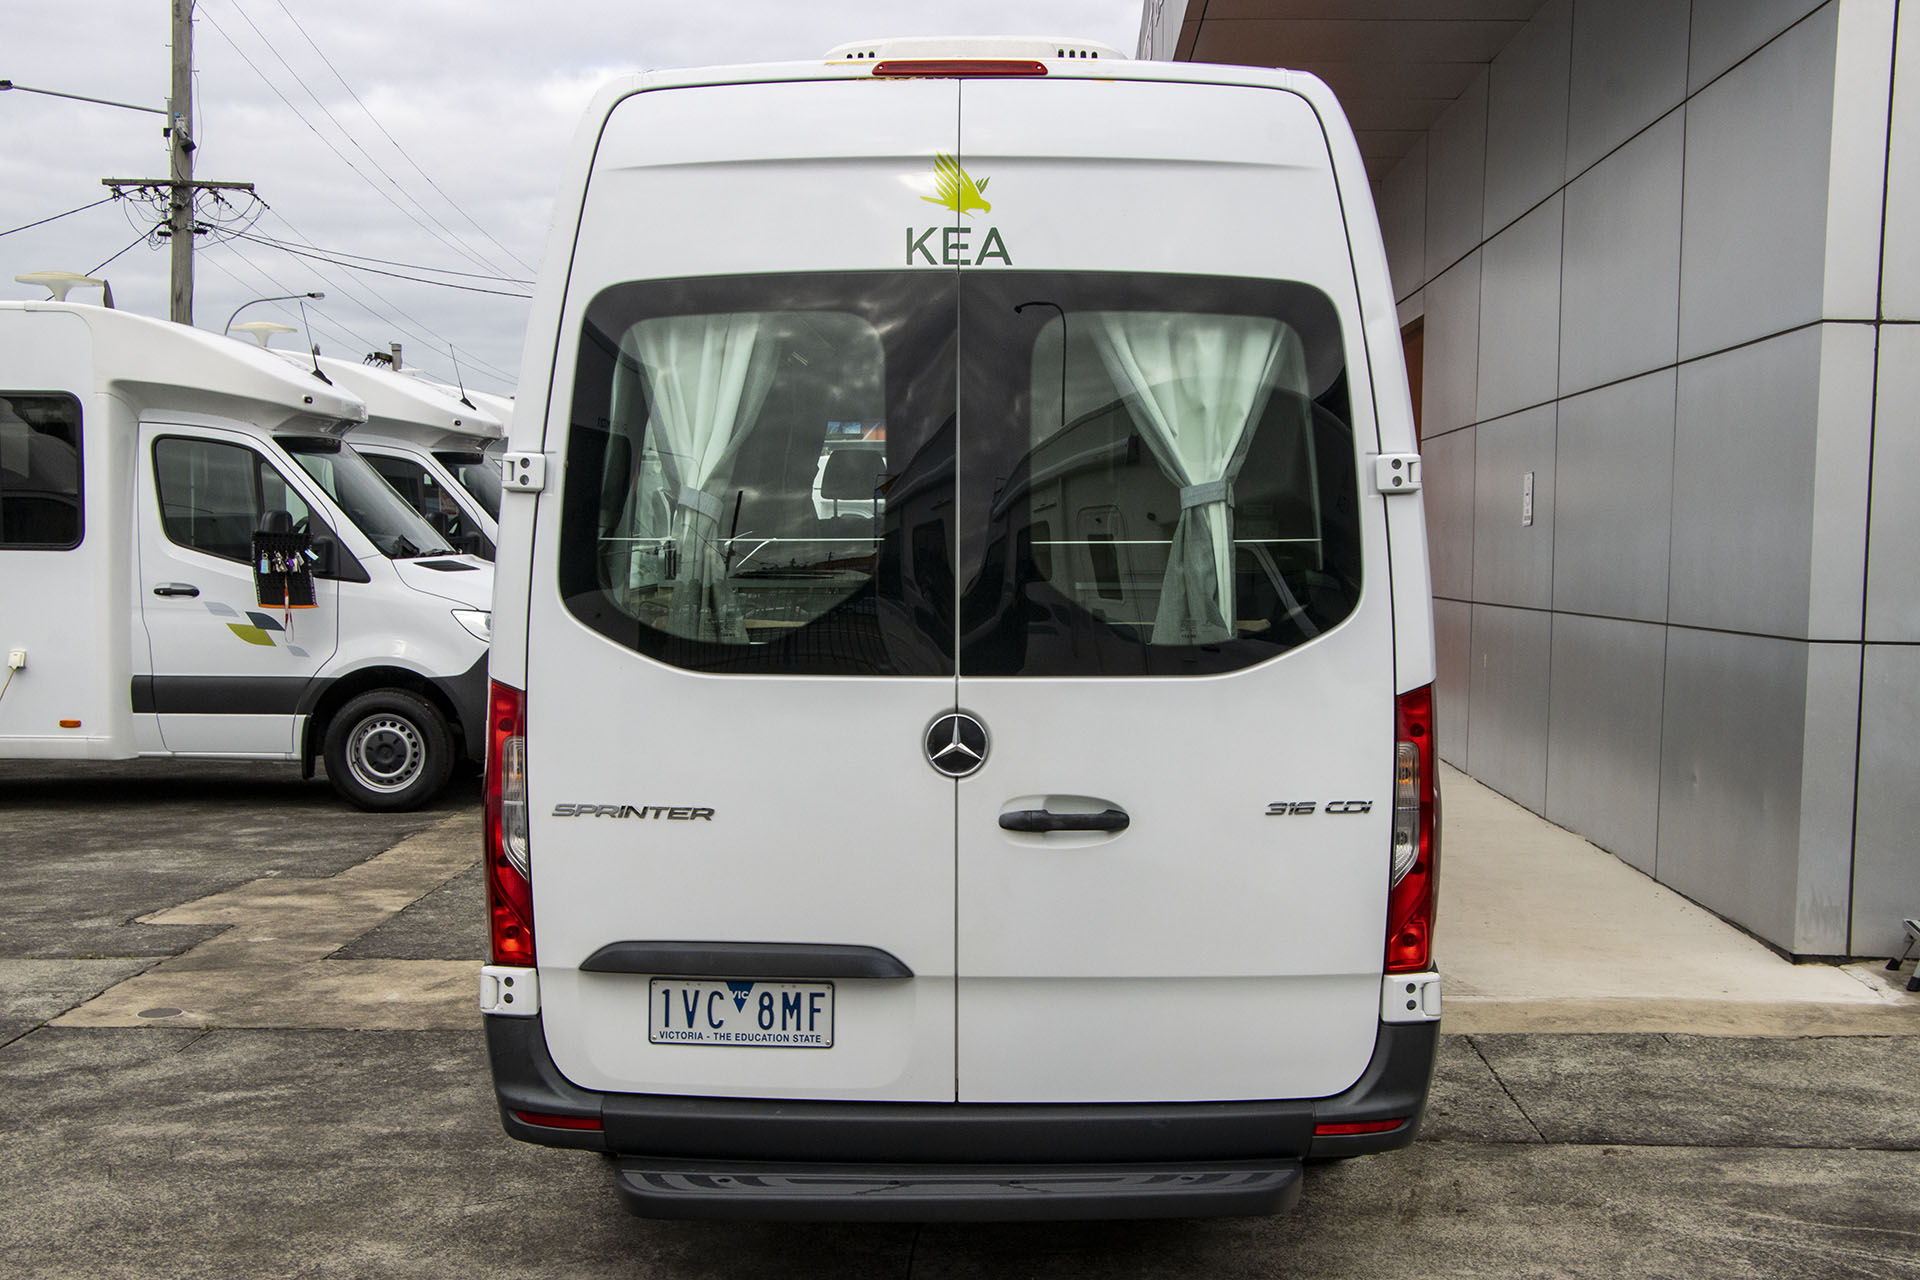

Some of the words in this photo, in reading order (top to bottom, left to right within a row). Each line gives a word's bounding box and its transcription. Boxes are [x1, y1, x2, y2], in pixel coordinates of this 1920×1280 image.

[906, 227, 1013, 266] KEA
[552, 803, 715, 821] SPRINTER
[1265, 801, 1317, 816] 316
[1325, 800, 1373, 814] CDI
[730, 990, 750, 1000] VIC
[662, 989, 724, 1029] 1VC
[758, 991, 825, 1031] 8MF
[659, 1031, 703, 1040] VICTORIA
[713, 1032, 732, 1041] THE
[735, 1033, 790, 1043] EDUCATION
[792, 1034, 822, 1043] STATE
